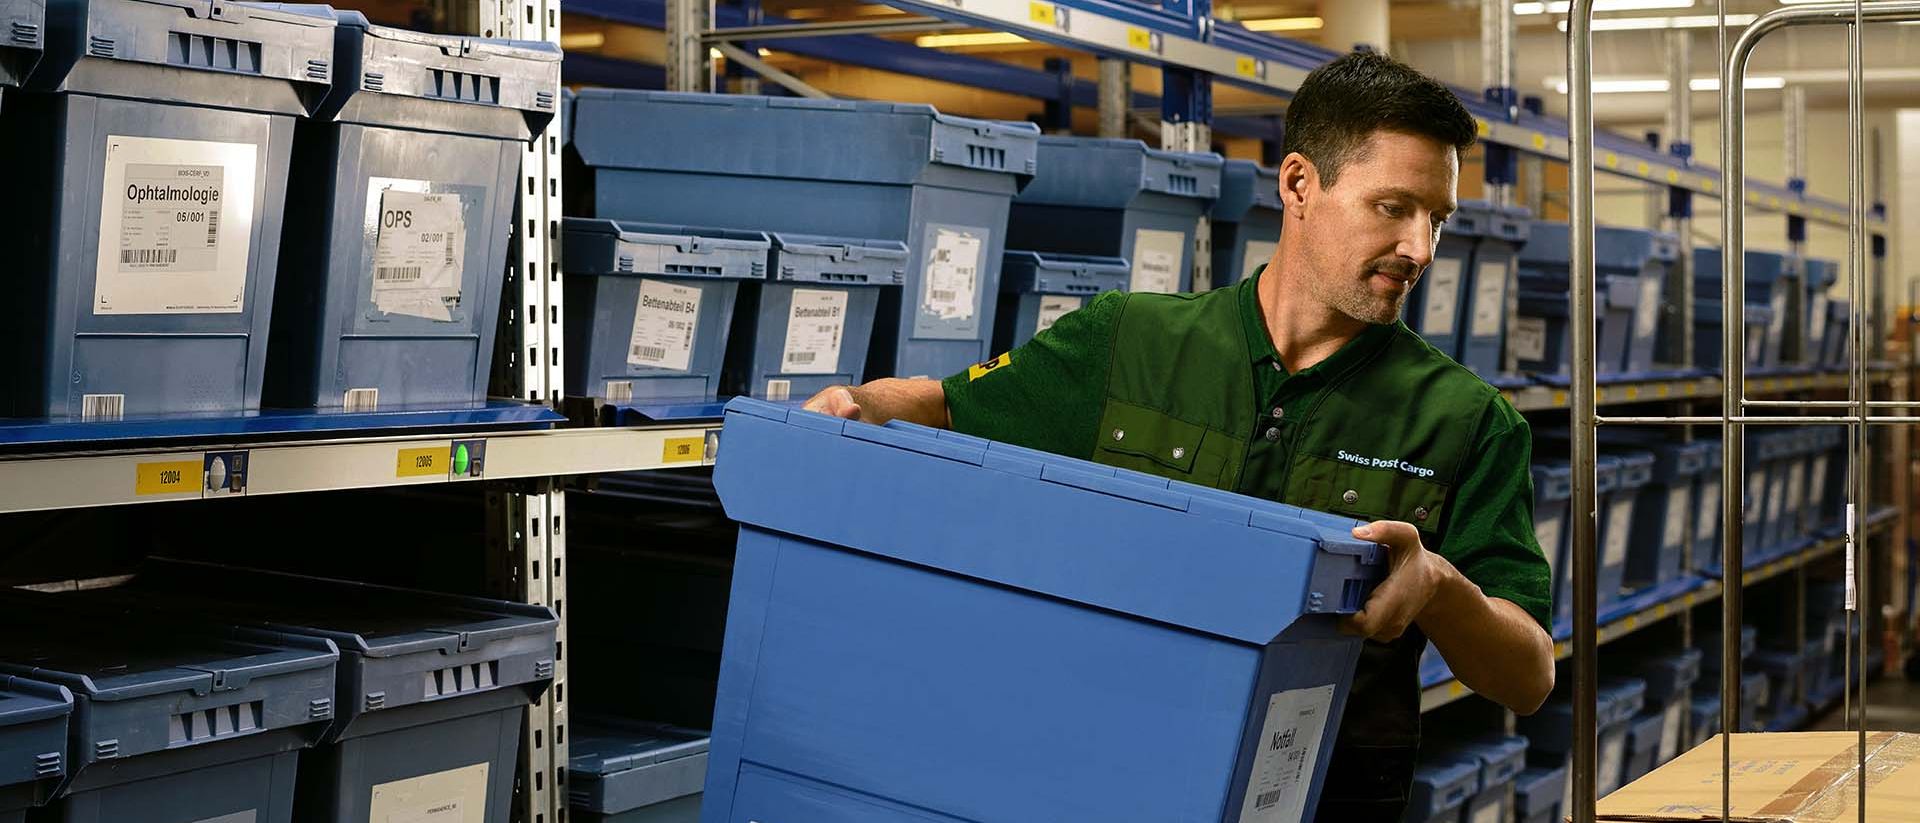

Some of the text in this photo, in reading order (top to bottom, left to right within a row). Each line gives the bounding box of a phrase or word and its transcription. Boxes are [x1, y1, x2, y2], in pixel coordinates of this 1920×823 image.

[127, 184, 219, 205] Ophtalmologie
[176, 211, 205, 222] 05/001
[384, 210, 412, 228] OPS
[642, 294, 696, 314] Bettenabteil B4
[416, 455, 433, 468] 12005
[1337, 450, 1434, 477] Swiss Post Cargo
[160, 470, 181, 485] 12004
[1269, 727, 1298, 752] Notfall
